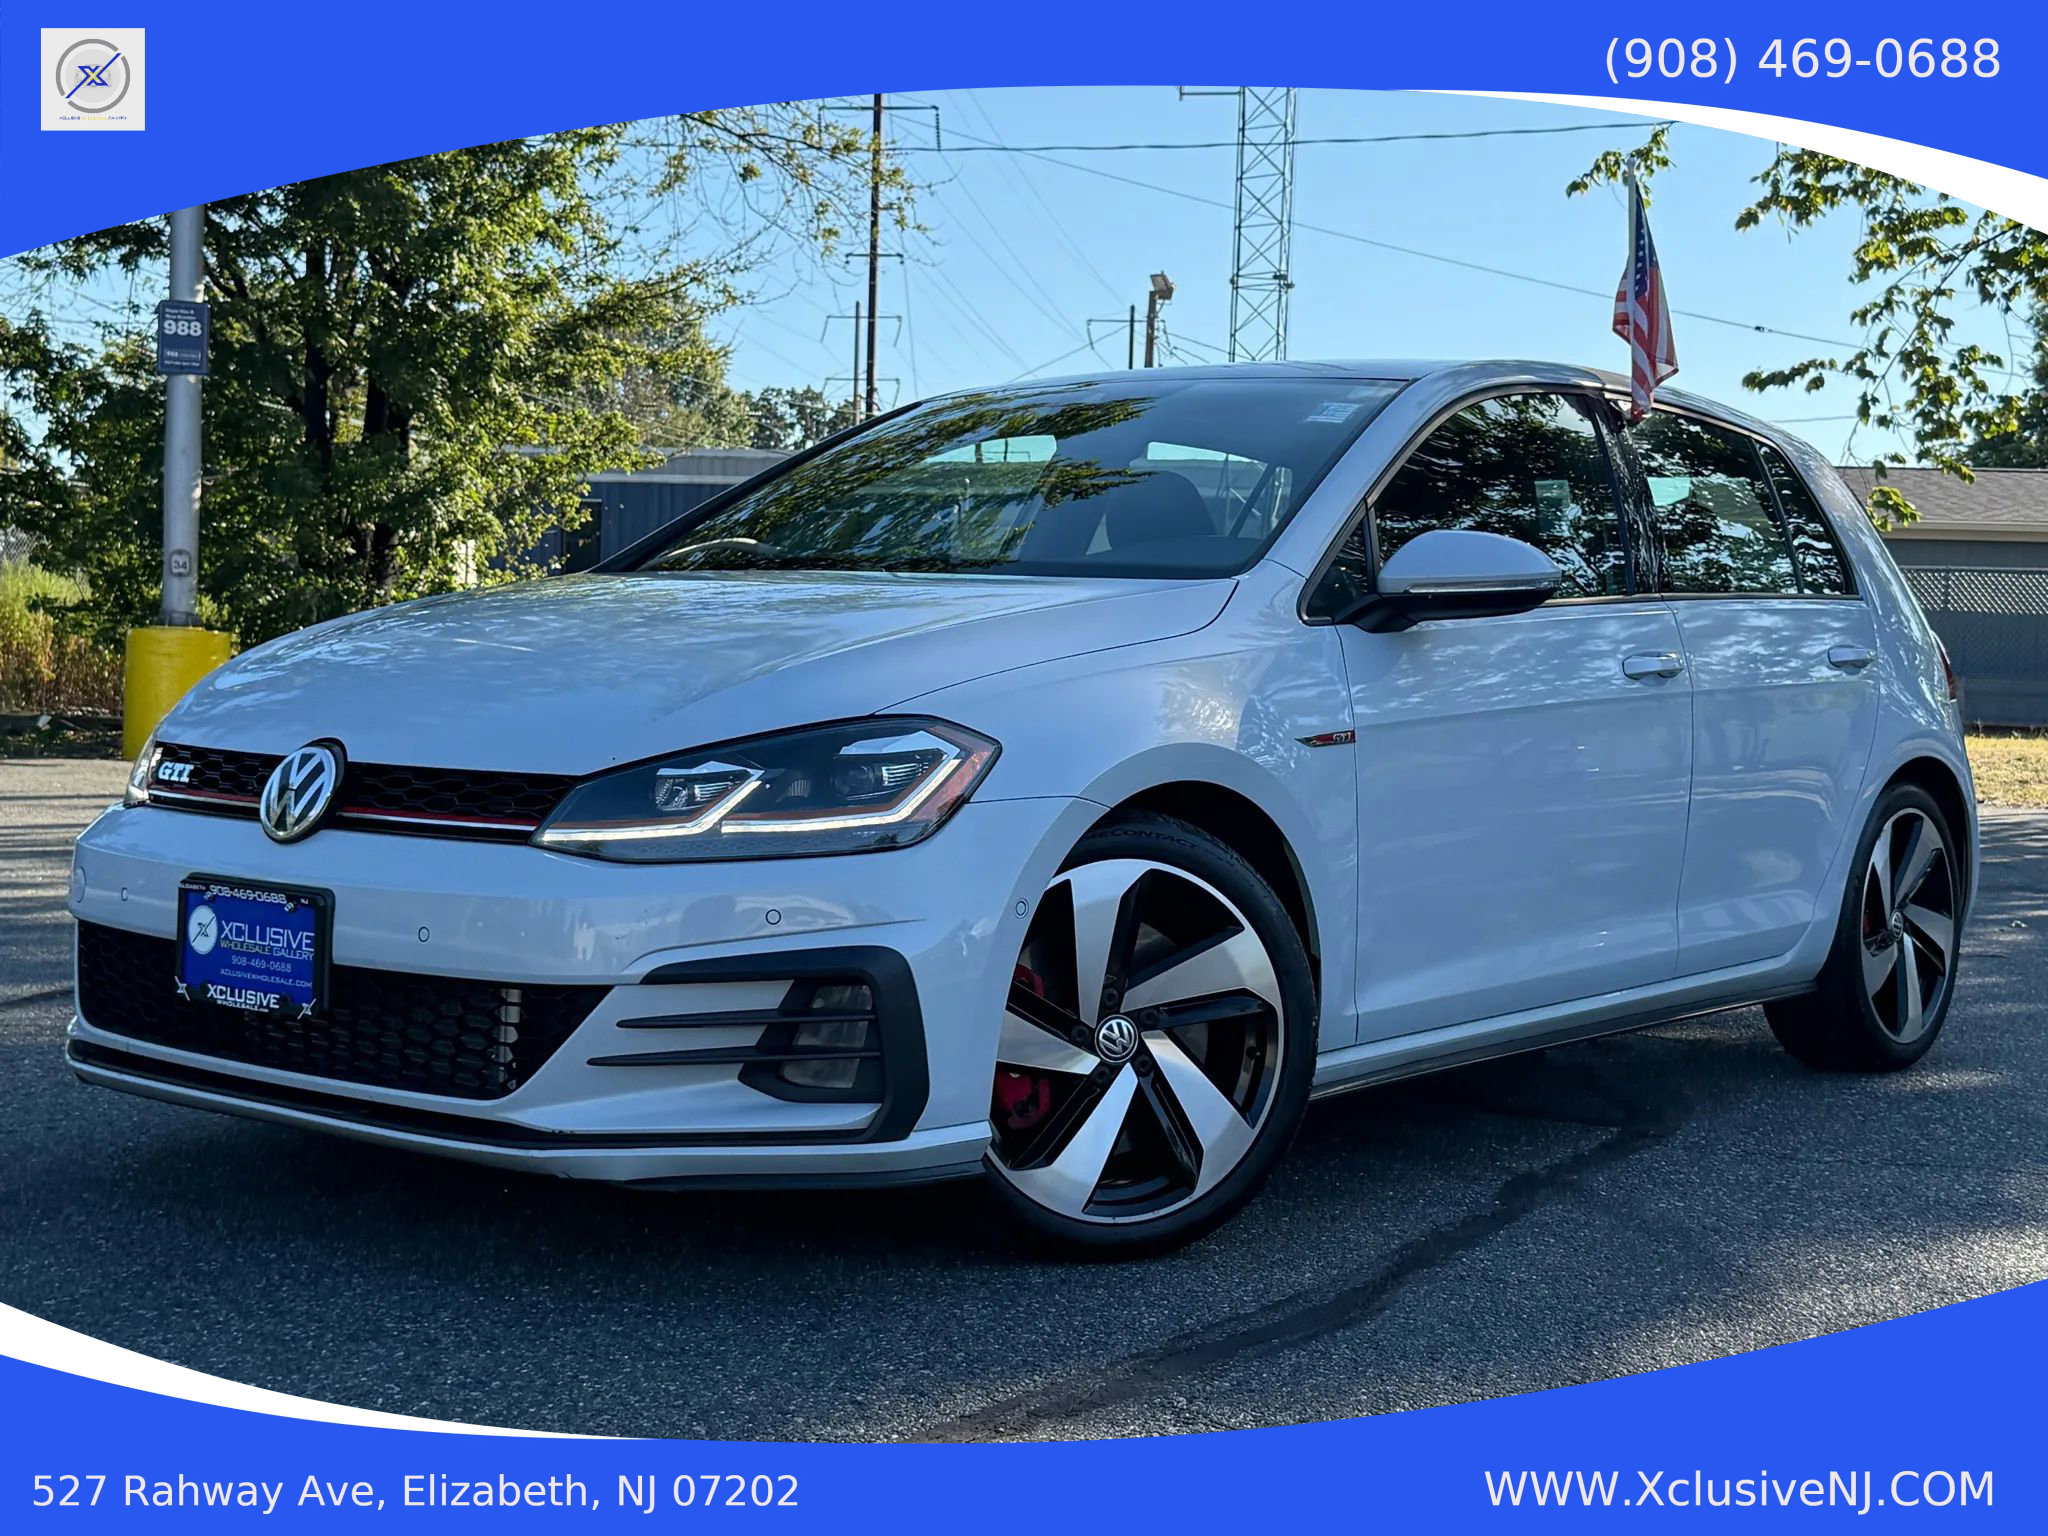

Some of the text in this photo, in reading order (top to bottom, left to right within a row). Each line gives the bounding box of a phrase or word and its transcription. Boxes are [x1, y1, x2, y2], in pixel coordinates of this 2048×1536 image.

[163, 320, 202, 337] 988
[158, 761, 195, 783] GTI
[210, 885, 287, 904] 908-469-0688
[221, 920, 315, 951] XCLUSIVE
[220, 940, 315, 960] WHOLESALE GALLERY
[231, 955, 292, 973] 908-469-0688
[207, 983, 280, 1009] XCLUSIVE
